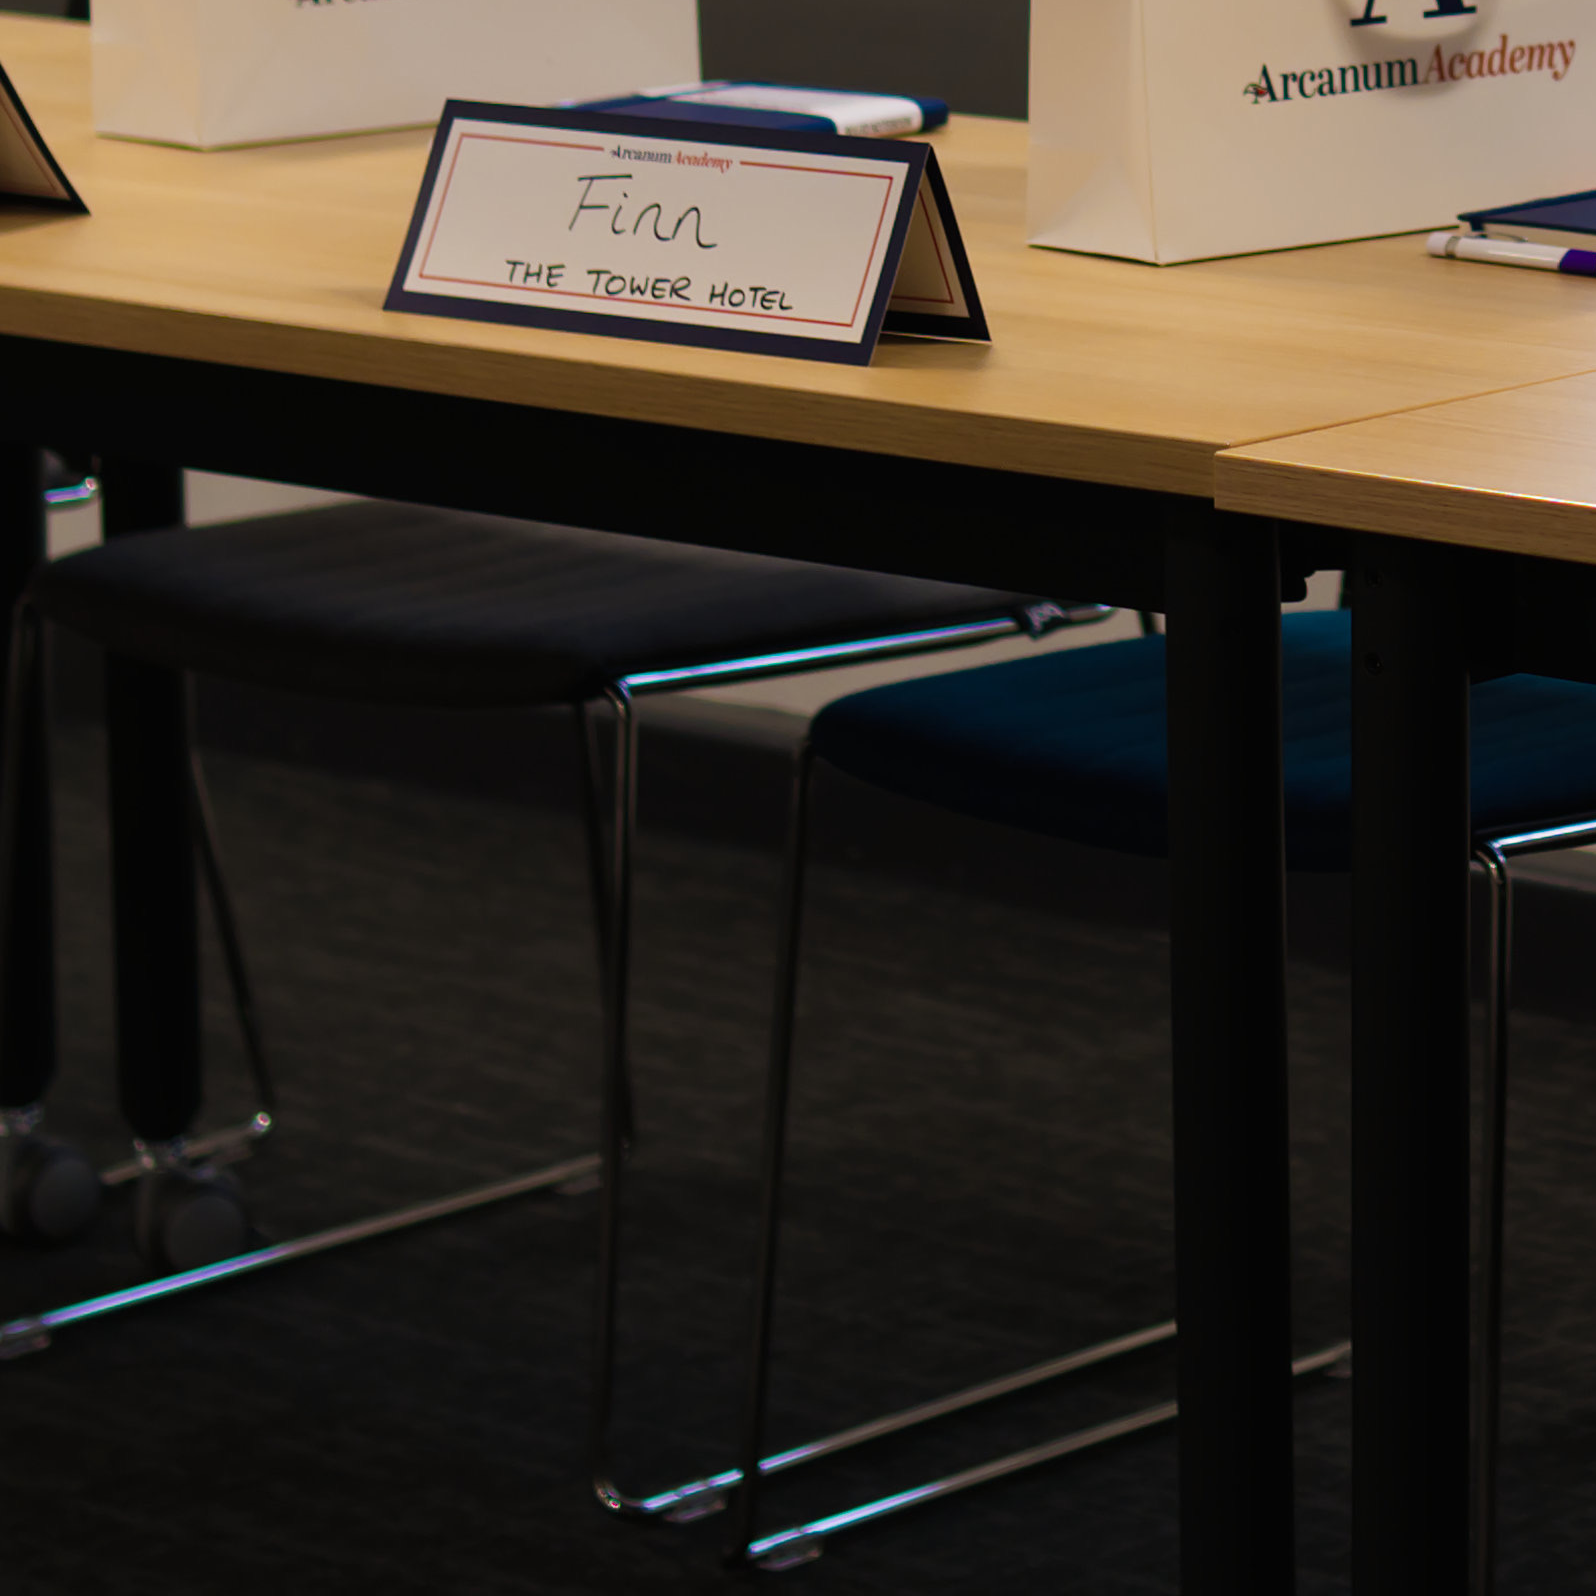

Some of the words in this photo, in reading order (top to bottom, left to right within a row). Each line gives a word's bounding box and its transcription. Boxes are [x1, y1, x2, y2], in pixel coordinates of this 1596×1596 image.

[1243, 58, 1419, 105] Arcanum
[1423, 35, 1577, 87] Academy
[610, 144, 672, 164] Arcanum
[674, 149, 733, 173] Academy
[568, 173, 718, 249] Finn
[504, 259, 566, 288] THE
[586, 269, 692, 302] TOWER
[708, 281, 794, 311] HOTEL
